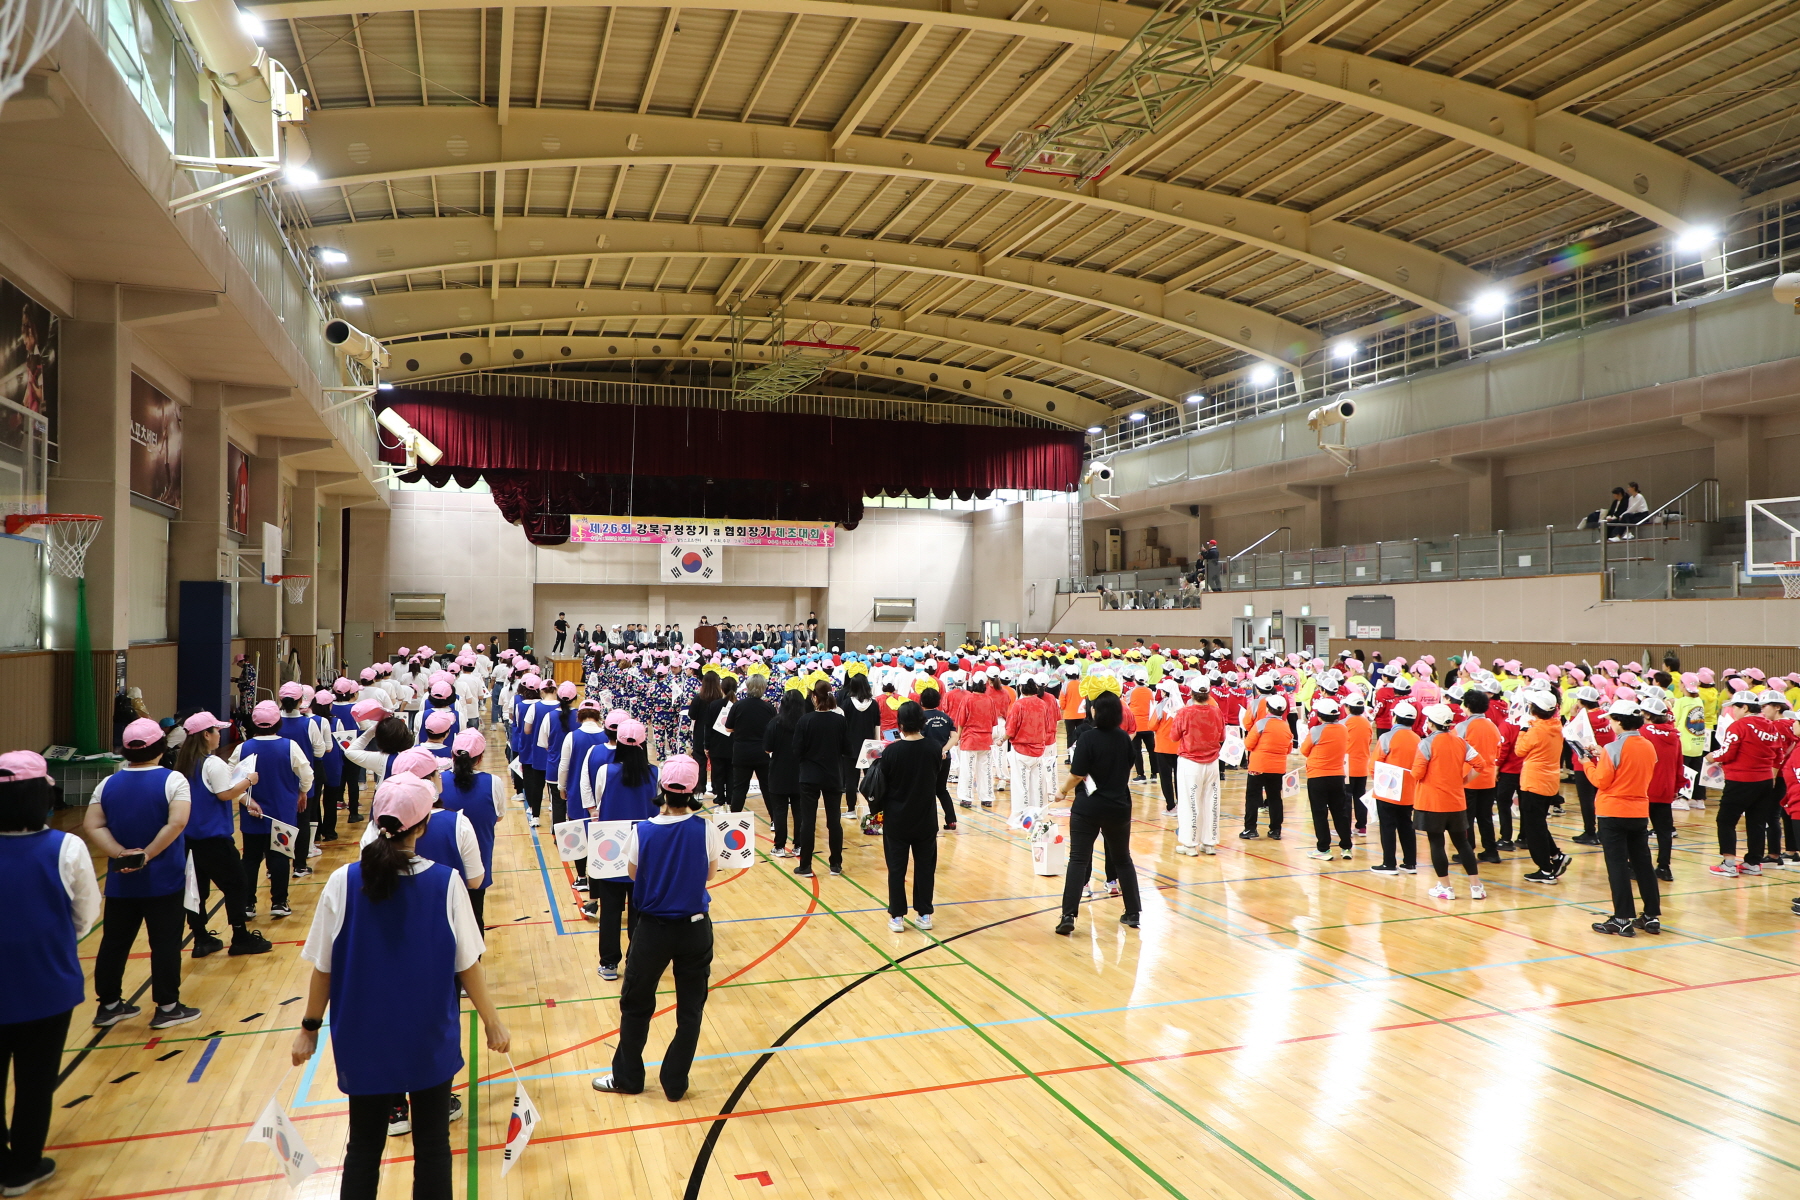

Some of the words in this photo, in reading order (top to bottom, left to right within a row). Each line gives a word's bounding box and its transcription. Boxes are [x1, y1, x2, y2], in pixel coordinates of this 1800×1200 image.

[589, 523, 632, 534] 제26회
[636, 524, 709, 536] 강북구청장기
[725, 526, 771, 538] 협회장기
